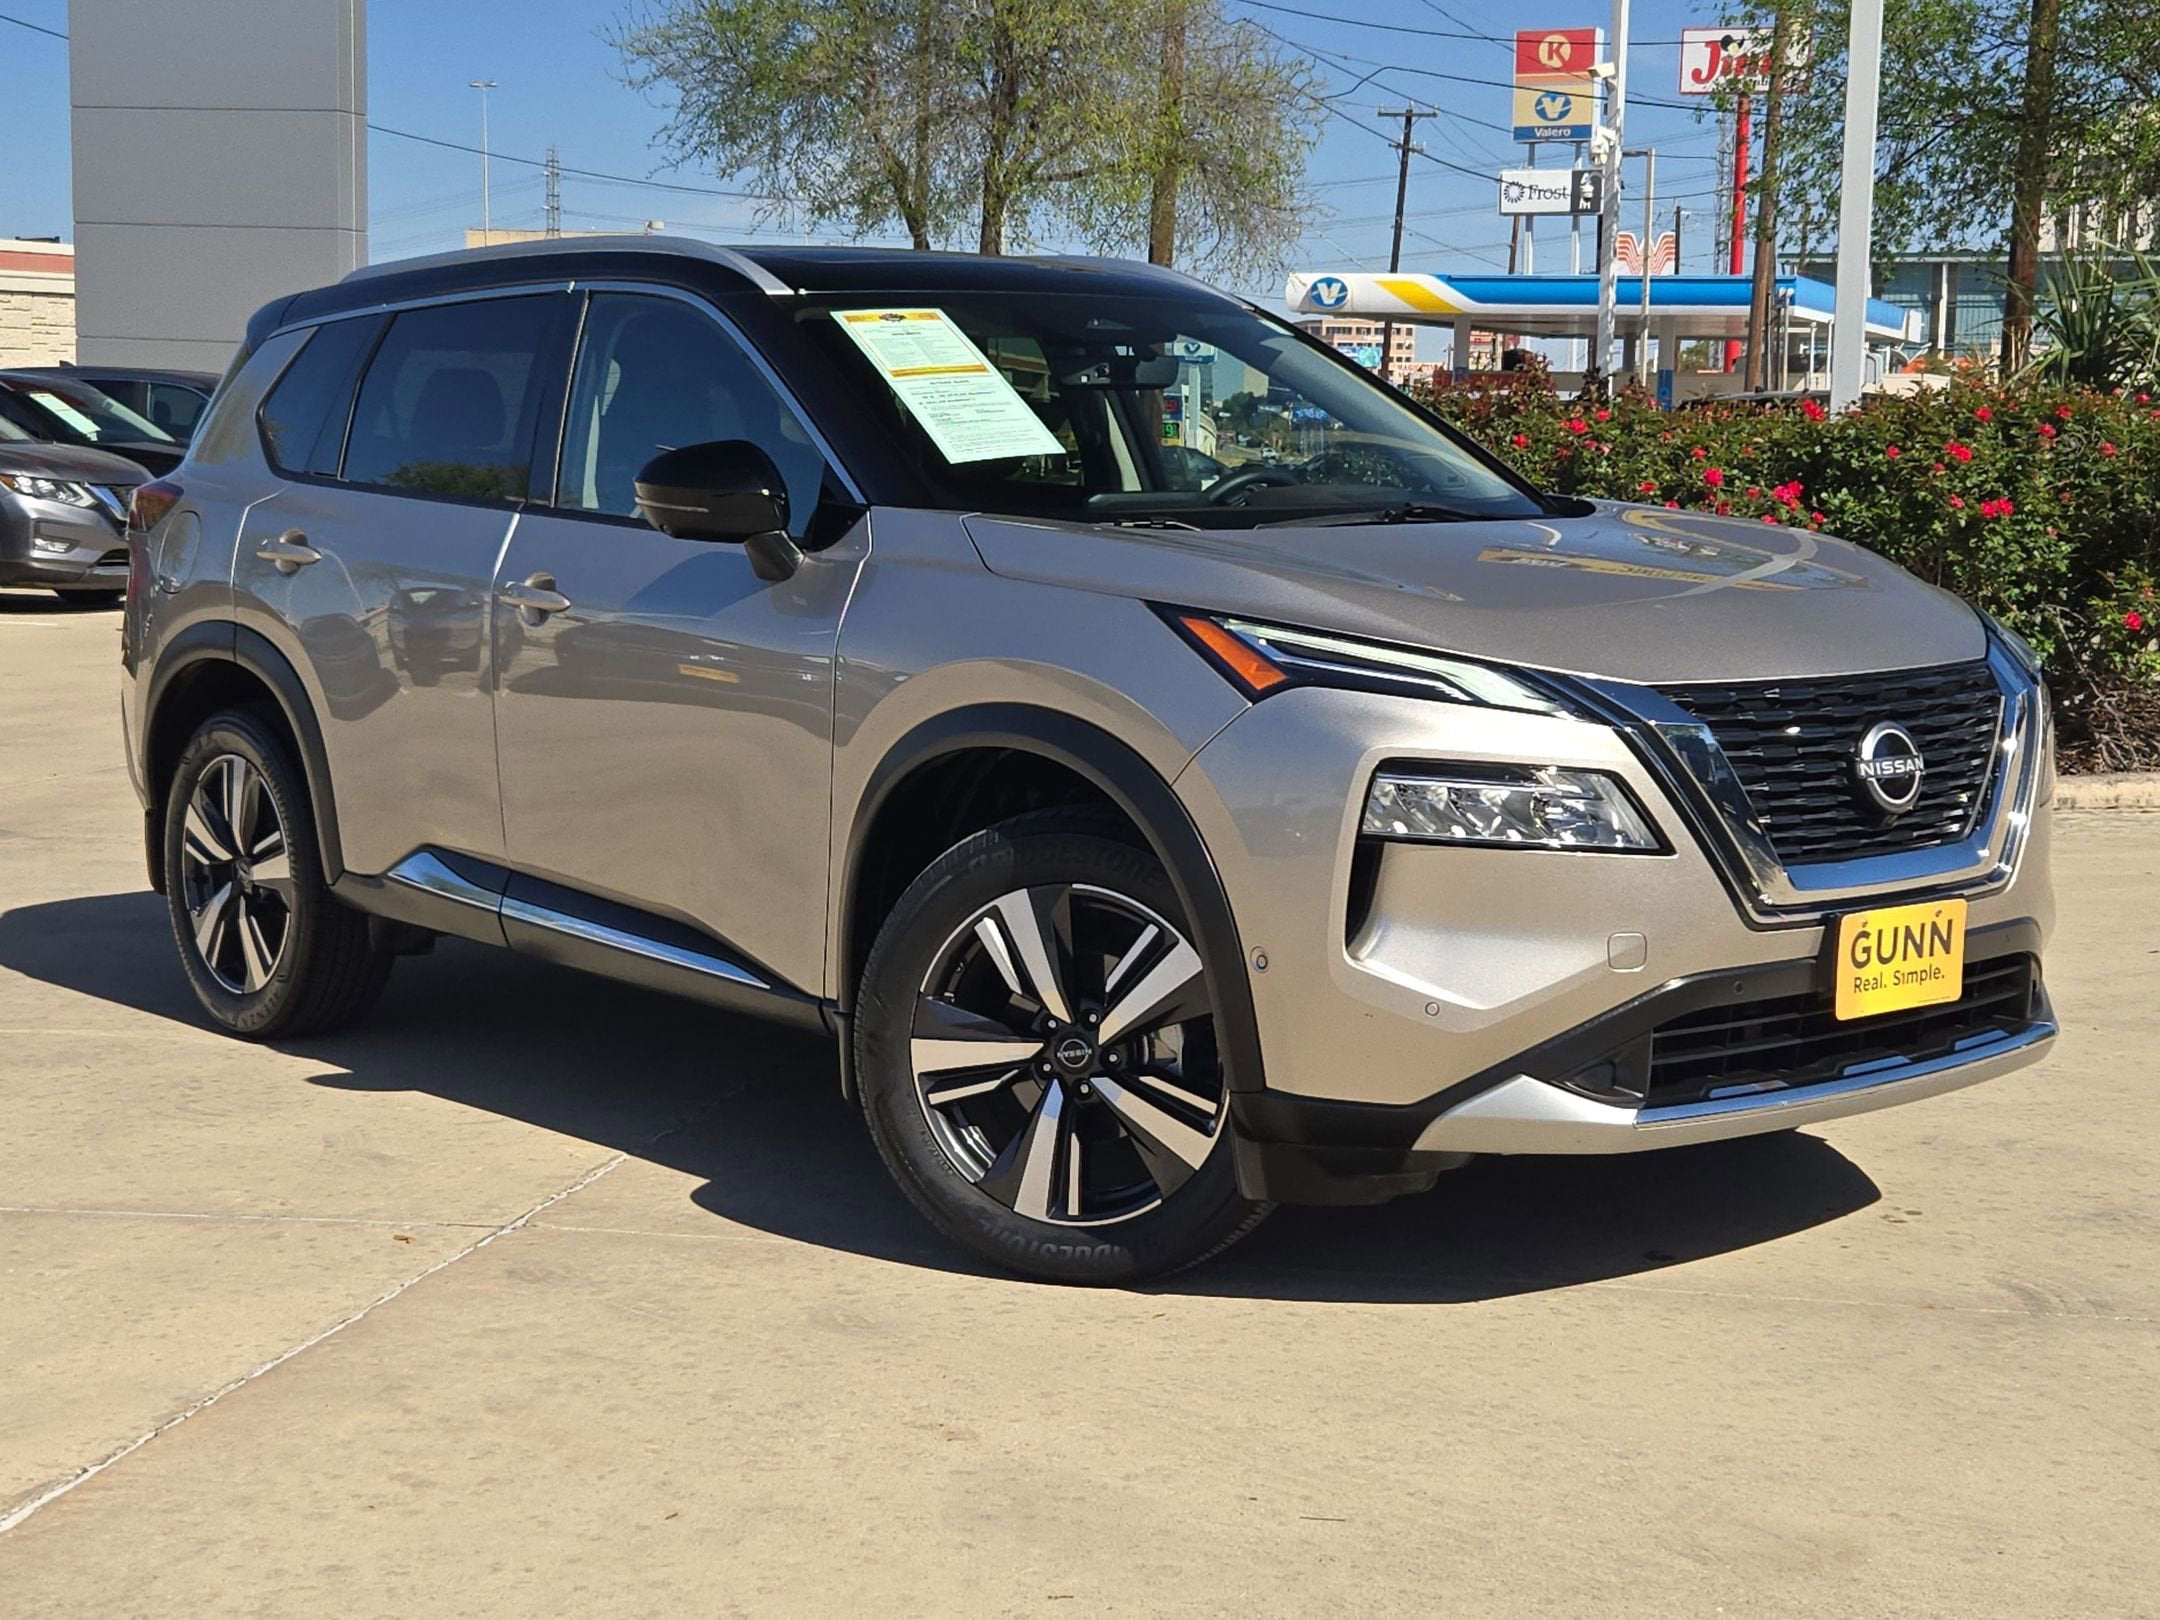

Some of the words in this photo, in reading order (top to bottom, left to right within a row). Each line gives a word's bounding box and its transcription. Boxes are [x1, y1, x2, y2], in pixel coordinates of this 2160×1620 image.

[1534, 127, 1572, 137] Valero
[1527, 184, 1568, 200] Frost
[1860, 754, 1924, 776] NISSAN
[1850, 918, 1953, 970] GUNN
[1853, 971, 1887, 994] Real.
[1892, 963, 1945, 986] Simple.
